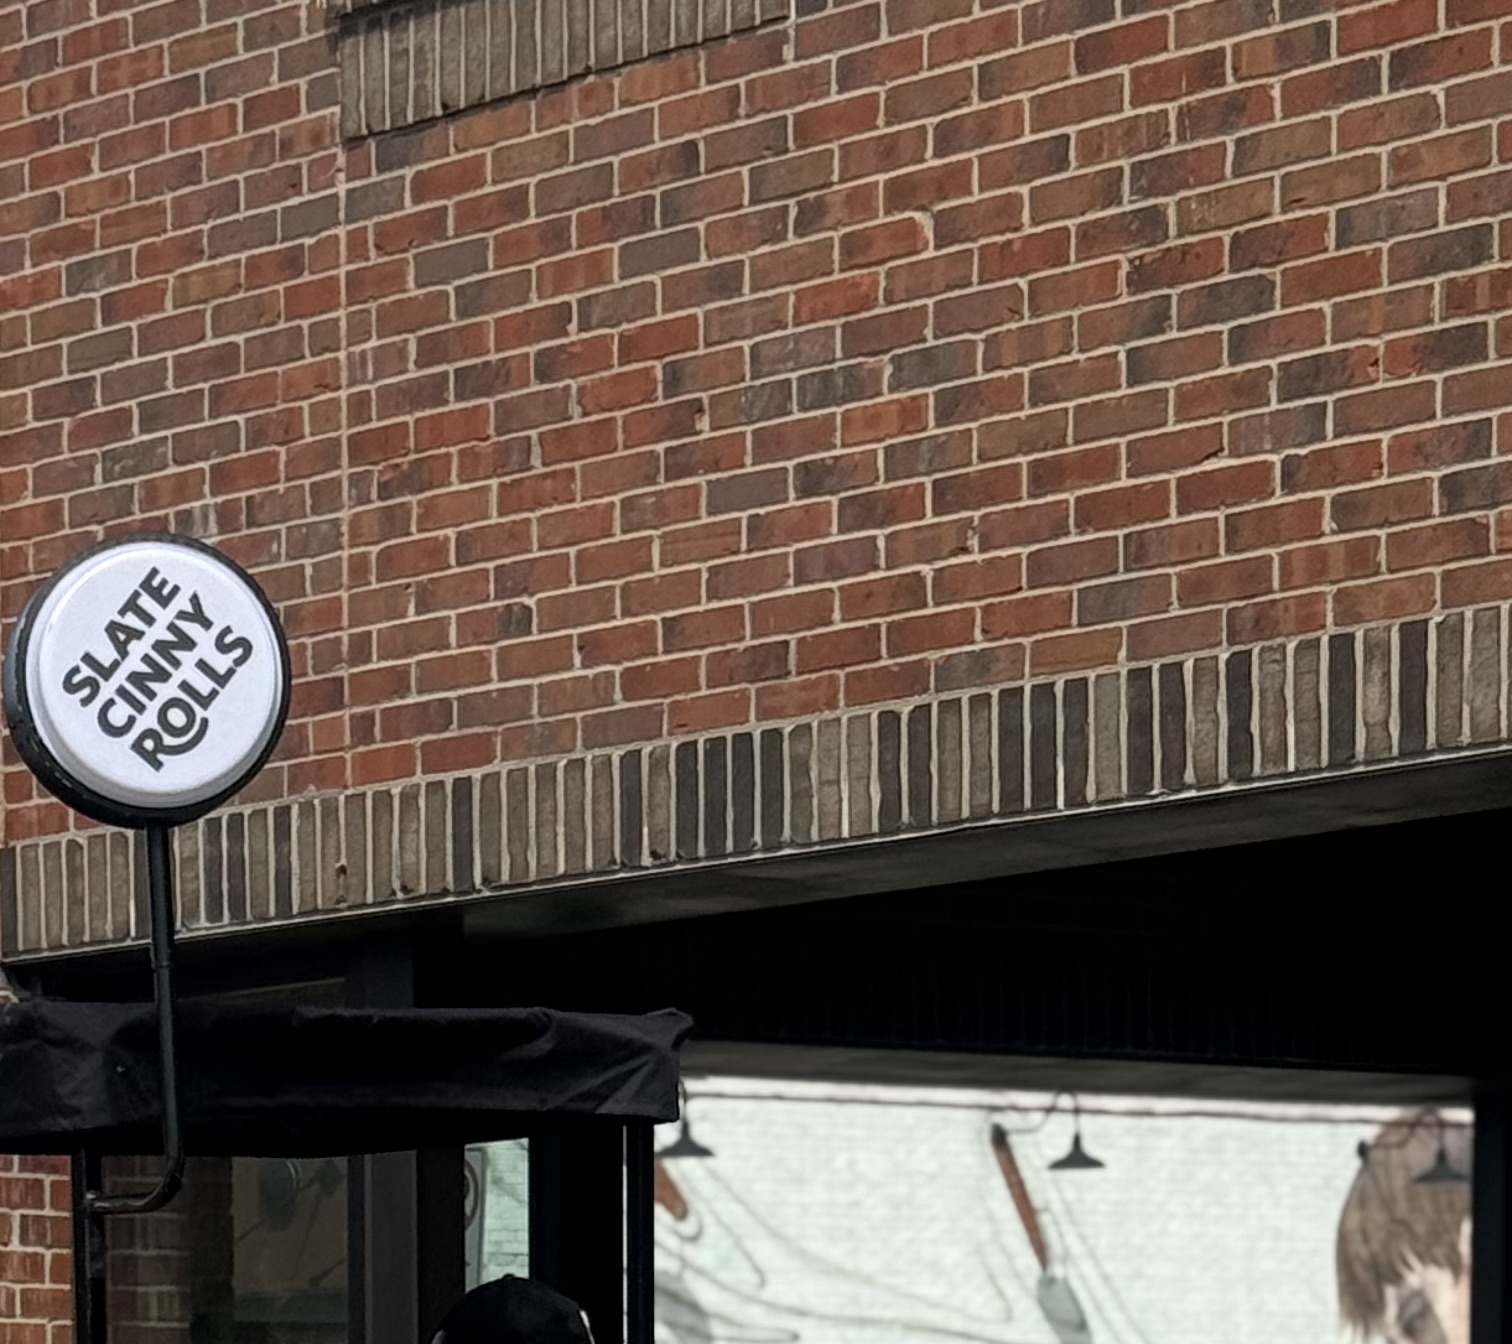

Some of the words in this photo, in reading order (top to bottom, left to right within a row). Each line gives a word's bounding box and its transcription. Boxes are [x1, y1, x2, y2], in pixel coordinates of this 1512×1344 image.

[61, 565, 181, 708] SLATE
[96, 589, 215, 739] CINNY
[130, 624, 254, 773] ROLLS
